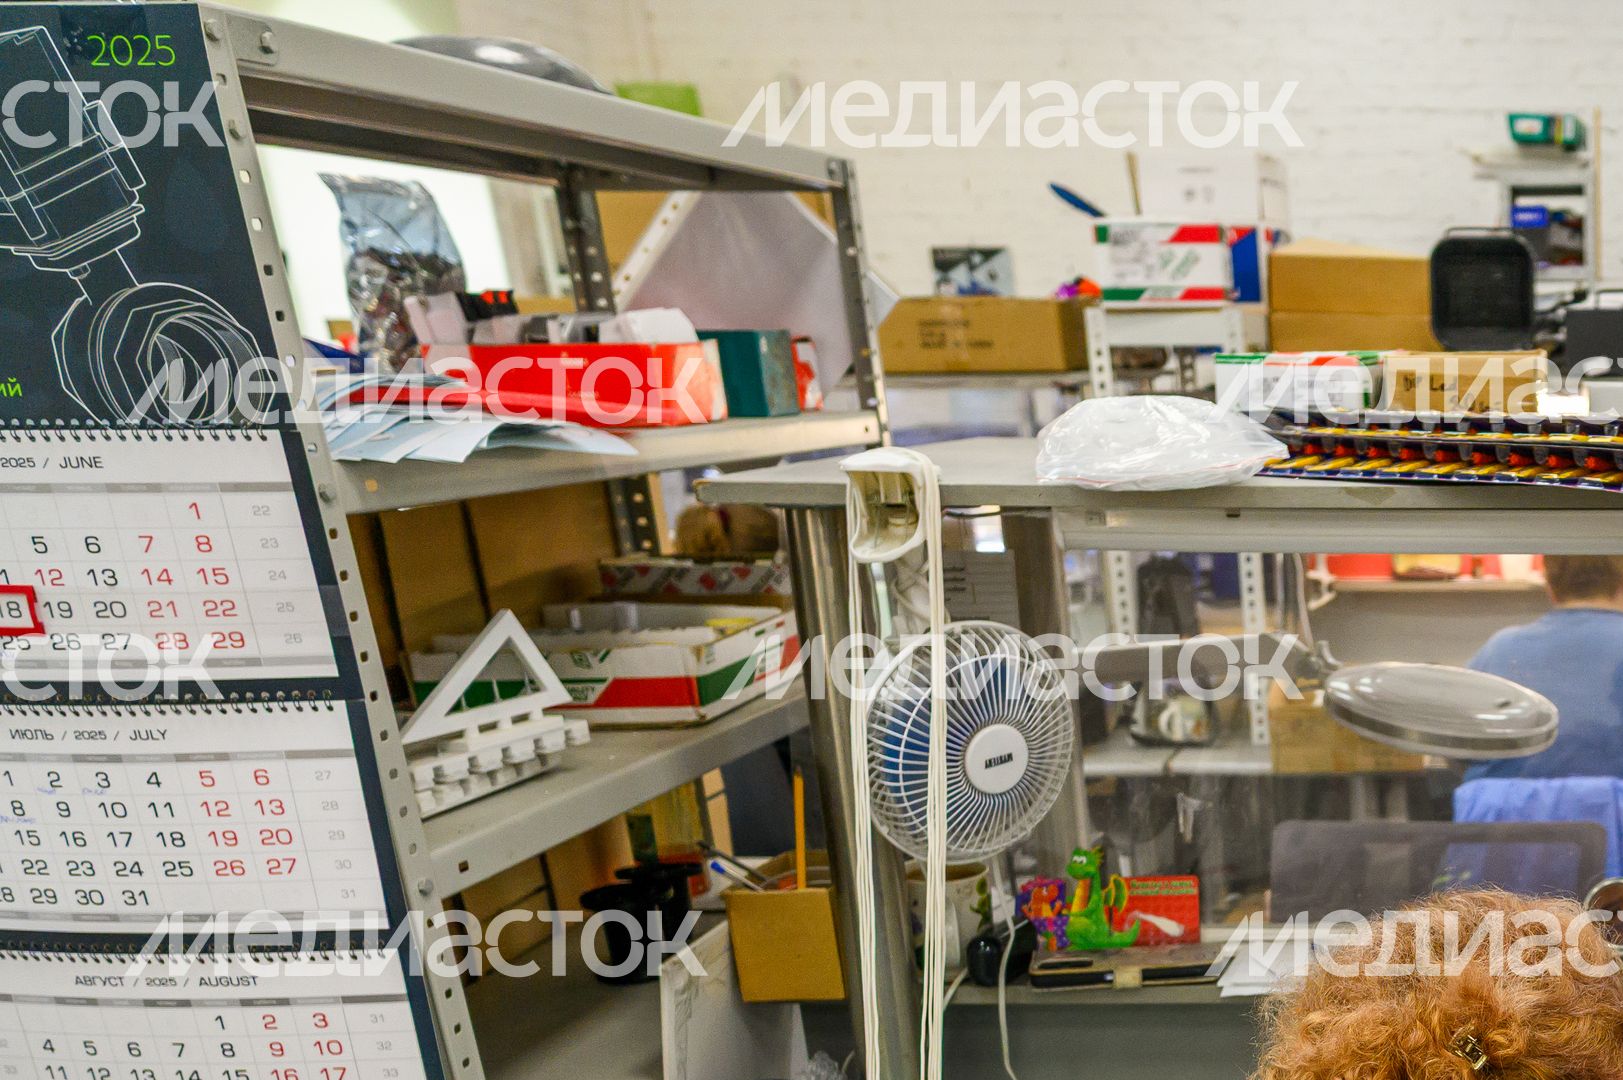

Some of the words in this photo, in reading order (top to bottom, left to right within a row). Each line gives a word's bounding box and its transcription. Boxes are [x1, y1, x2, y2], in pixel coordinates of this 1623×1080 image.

[88, 34, 176, 67] 2025
[0, 377, 22, 397] ий
[0, 457, 35, 468] 2025
[60, 456, 103, 468] JUNE
[189, 502, 200, 519] 1
[32, 536, 48, 553] 5
[85, 536, 101, 553] 6
[139, 536, 153, 553] 7
[195, 535, 212, 552] 8
[0, 569, 9, 585] 1
[35, 569, 64, 586] 12
[87, 569, 118, 586] 13
[141, 568, 173, 585] 14
[197, 568, 229, 585] 15
[43, 601, 72, 618] 19
[94, 601, 126, 618] 20
[148, 601, 177, 618] 21
[203, 600, 237, 617] 22
[51, 634, 82, 651] 26
[101, 633, 130, 650] 27
[155, 632, 189, 650] 28
[212, 631, 245, 649] 29
[10, 729, 54, 740] ИЮЛЬ
[74, 730, 107, 740] 2025
[130, 729, 167, 741] JULY
[3, 771, 13, 786] 1
[48, 771, 62, 788] 2
[95, 772, 110, 788] 3
[147, 772, 161, 787] 4
[199, 771, 215, 787] 5
[254, 769, 269, 785] 6
[11, 800, 25, 816] 8
[56, 801, 70, 817] 9
[99, 802, 127, 818] 10
[148, 802, 174, 817] 11
[201, 801, 231, 817] 12
[255, 799, 285, 815] 13
[15, 830, 40, 846] 15
[60, 831, 86, 847] 16
[107, 832, 132, 847] 17
[157, 832, 185, 847] 18
[208, 831, 238, 846] 19
[260, 829, 292, 845] 20
[21, 859, 49, 875] 22
[66, 861, 95, 876] 23
[114, 861, 144, 877] 24
[163, 861, 193, 877] 25
[214, 860, 245, 876] 26
[267, 858, 296, 875] 27
[1, 887, 14, 902] 8
[30, 888, 57, 904] 29
[75, 890, 104, 905] 30
[122, 890, 149, 905] 31
[75, 976, 124, 987] АВГУСТ
[145, 977, 177, 986] 2025
[199, 976, 257, 987] AUGUST
[215, 1016, 225, 1030] 1
[262, 1015, 277, 1030] 2
[313, 1013, 328, 1028] 3
[43, 1039, 55, 1052] 4
[83, 1041, 97, 1056] 5
[127, 1042, 141, 1057] 6
[173, 1043, 184, 1057] 7
[221, 1043, 235, 1057] 8
[269, 1042, 284, 1057] 9
[314, 1040, 342, 1055] 10
[46, 1065, 67, 1080] 11
